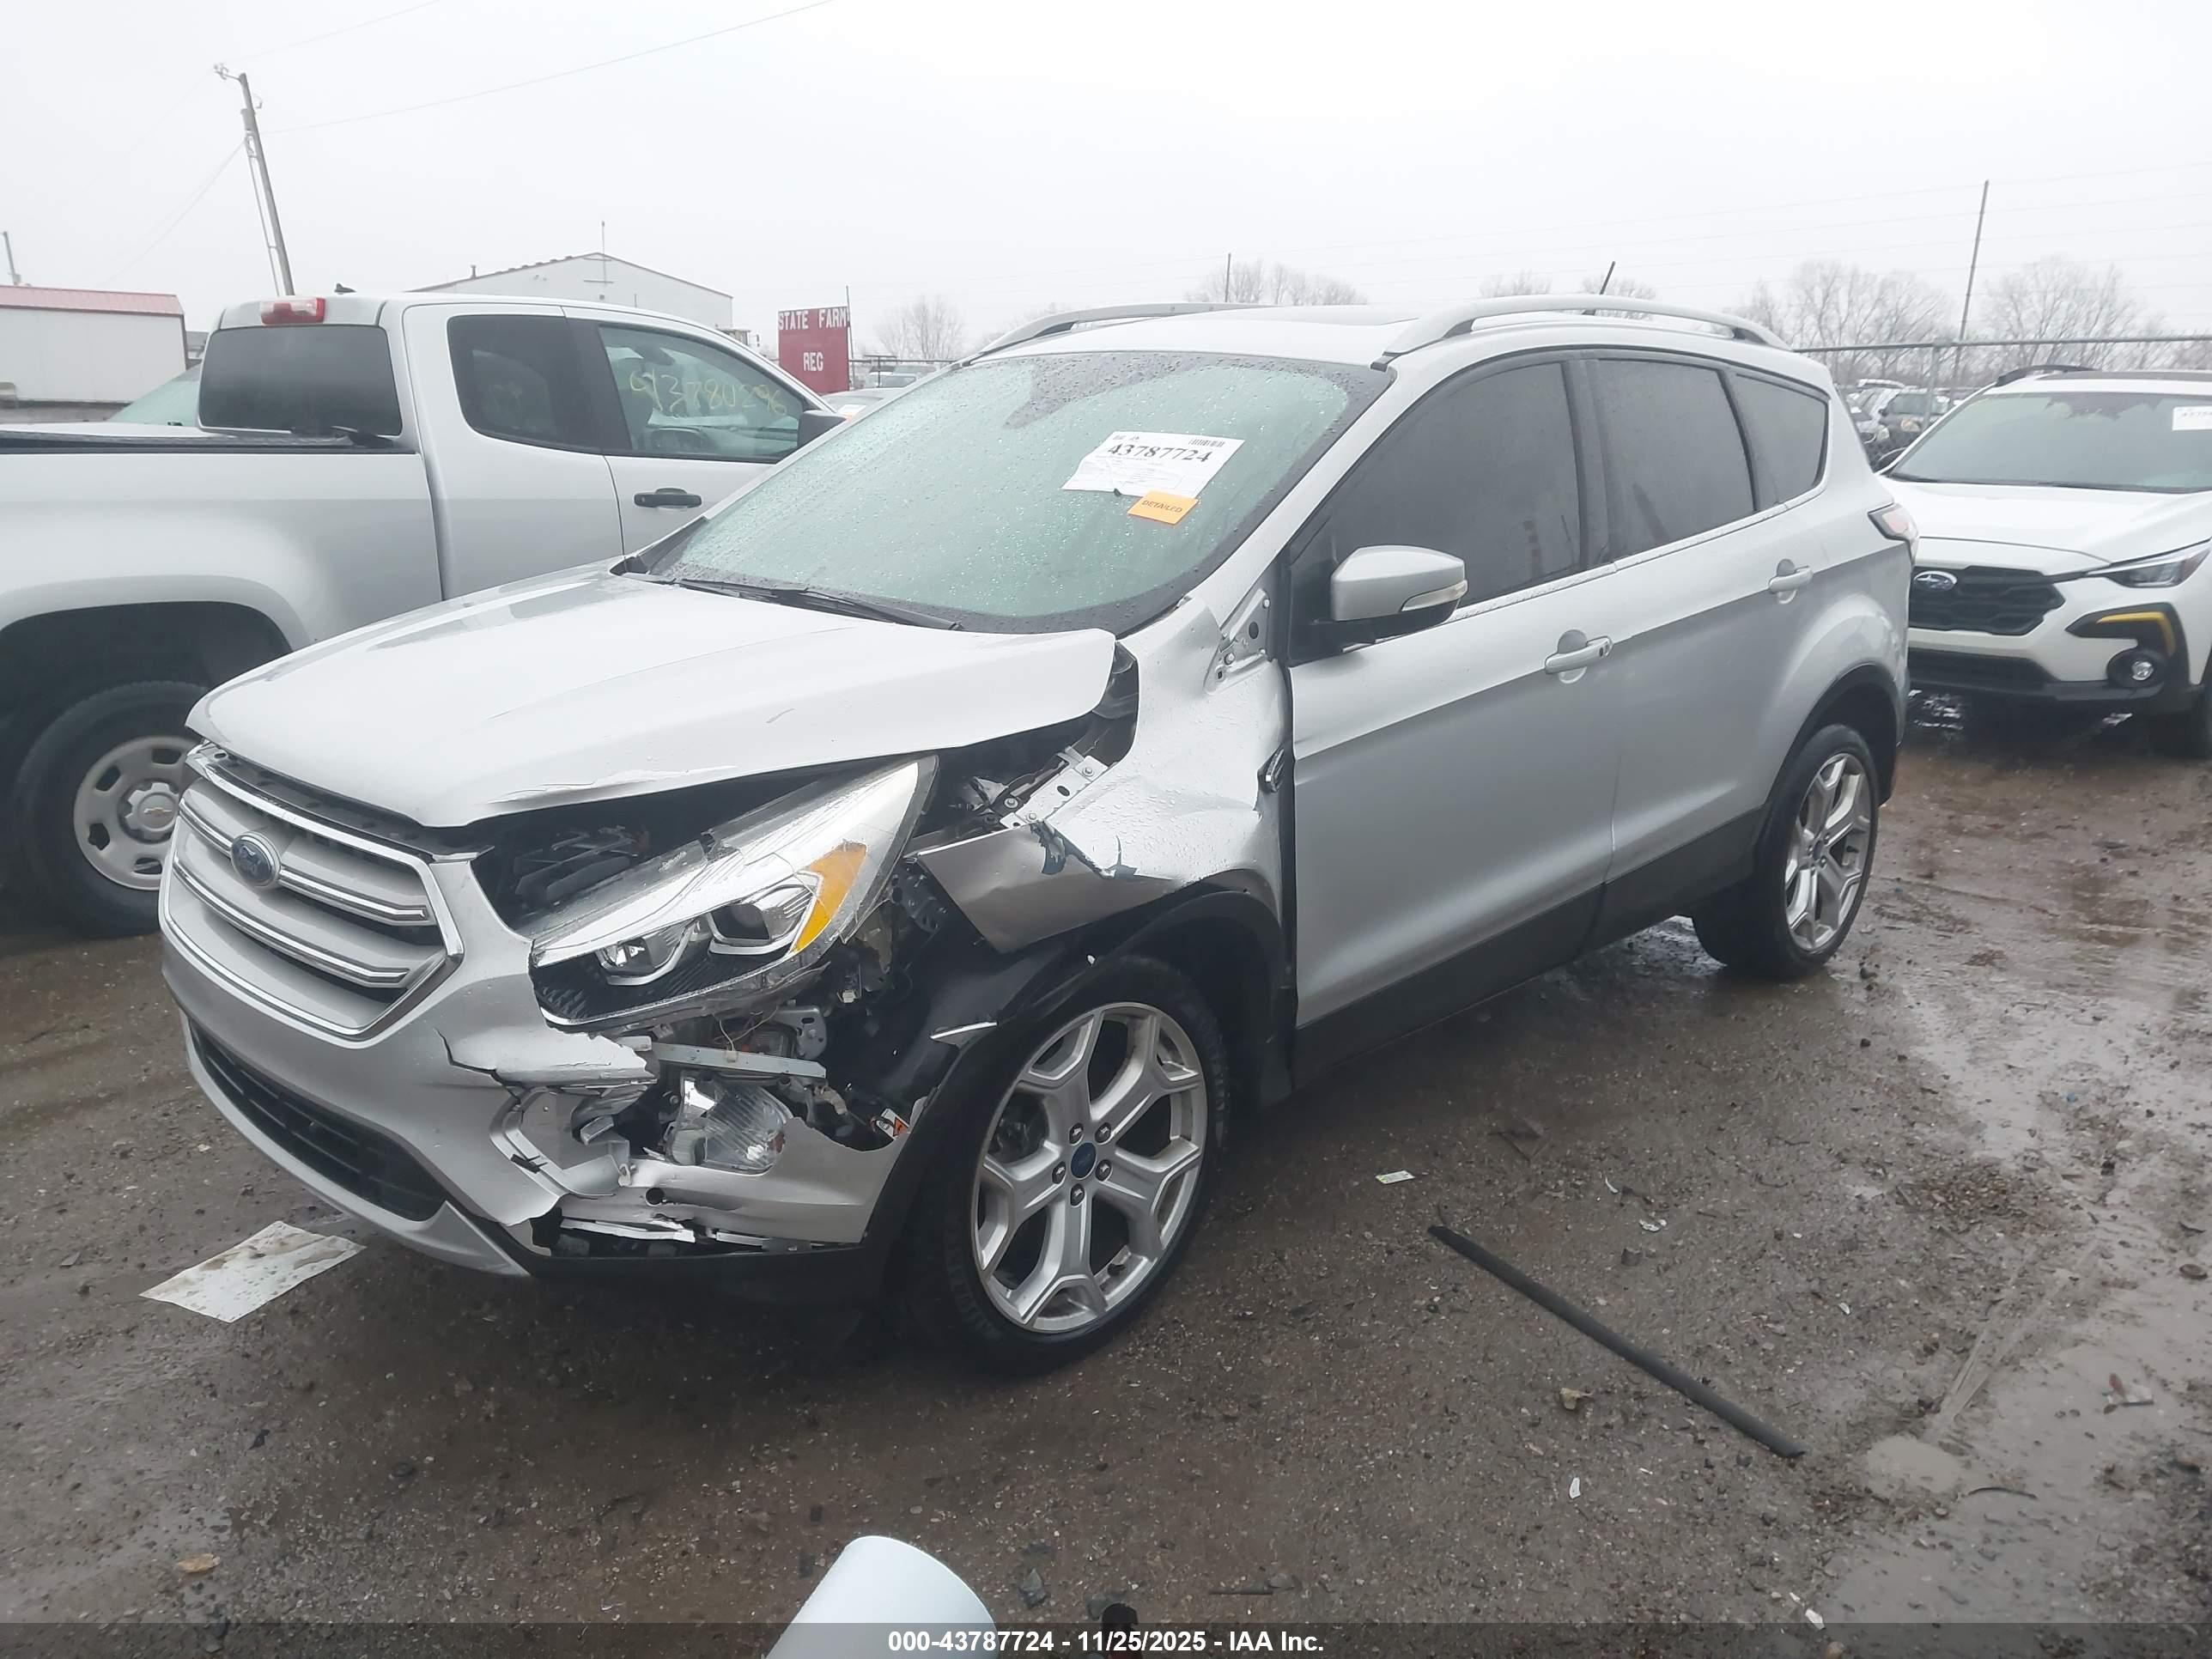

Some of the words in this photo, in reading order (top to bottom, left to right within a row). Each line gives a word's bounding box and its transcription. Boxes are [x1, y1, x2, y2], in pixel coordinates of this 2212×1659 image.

[778, 310, 809, 331] STATE
[818, 307, 848, 329] FARM
[803, 351, 823, 372] REG
[1108, 443, 1213, 463] 43787724
[1141, 500, 1183, 514] DETAILED
